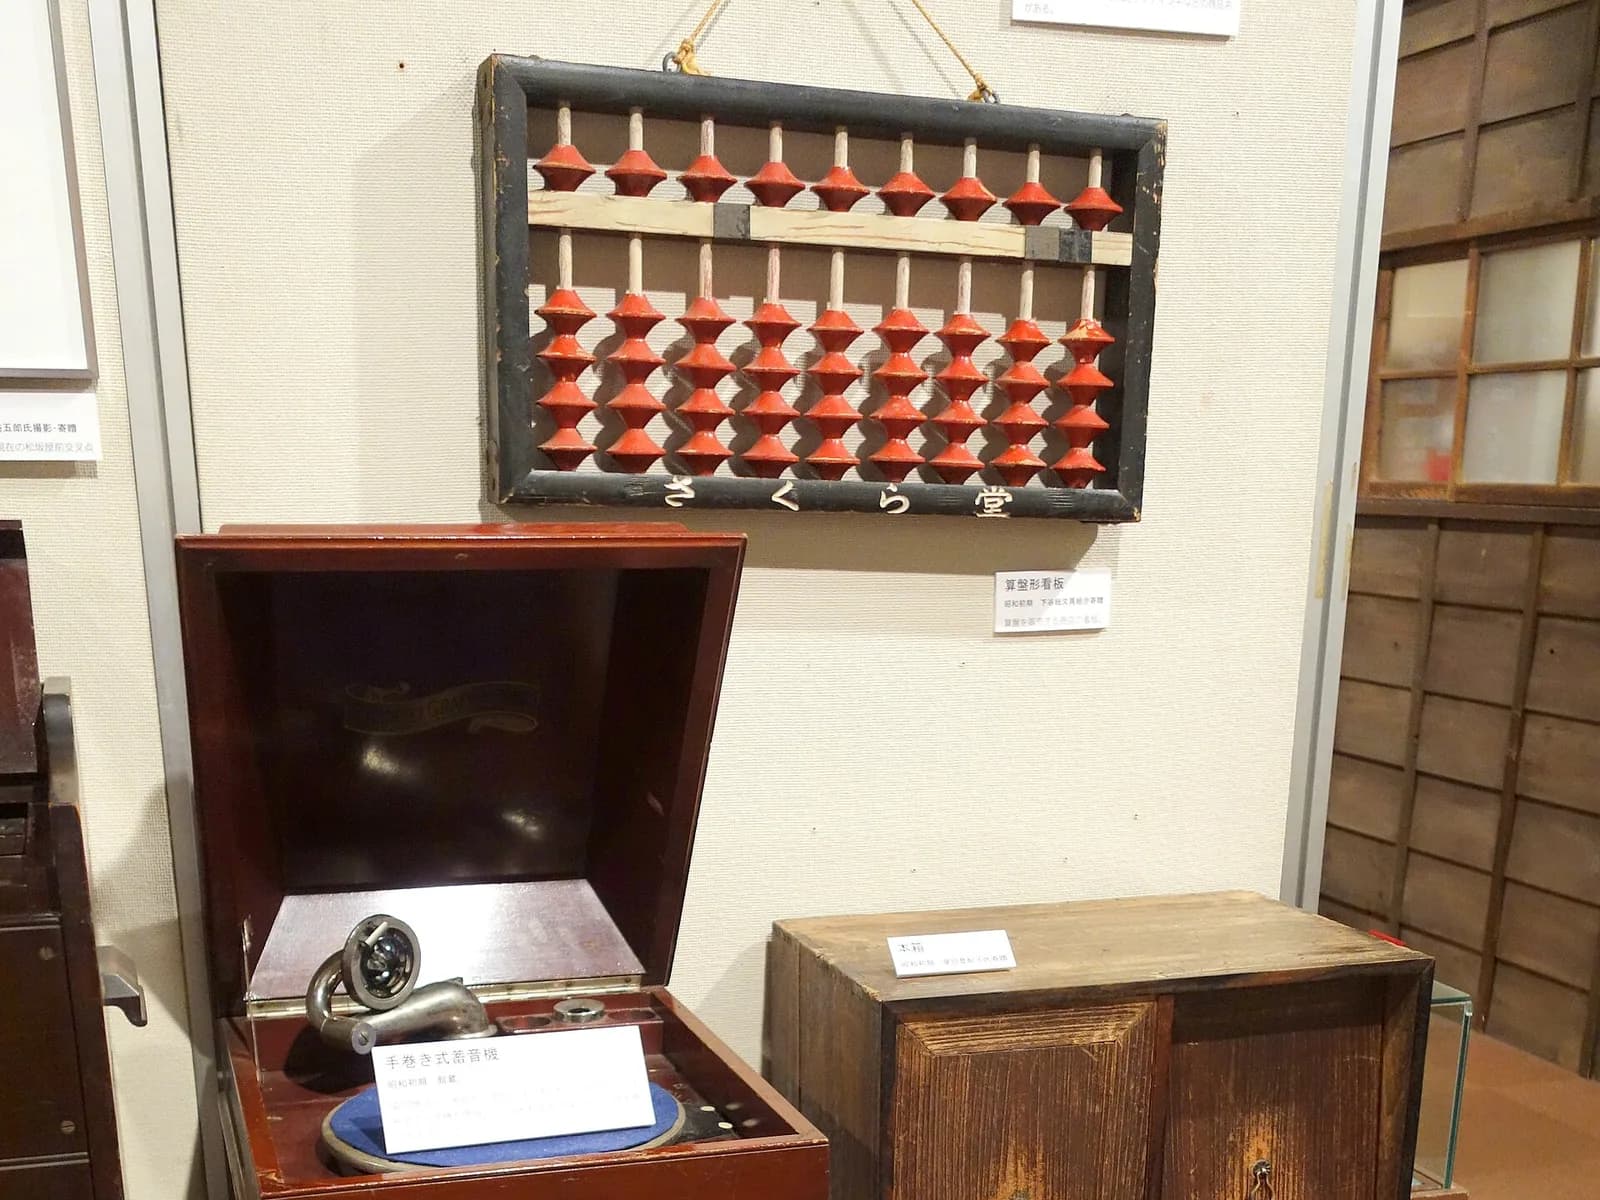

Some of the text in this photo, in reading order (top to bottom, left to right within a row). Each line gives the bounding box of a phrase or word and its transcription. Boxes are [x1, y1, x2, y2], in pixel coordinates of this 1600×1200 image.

[1004, 577, 1065, 592] 算盤形看板
[385, 1047, 501, 1070] 手巻き式蓄音機
